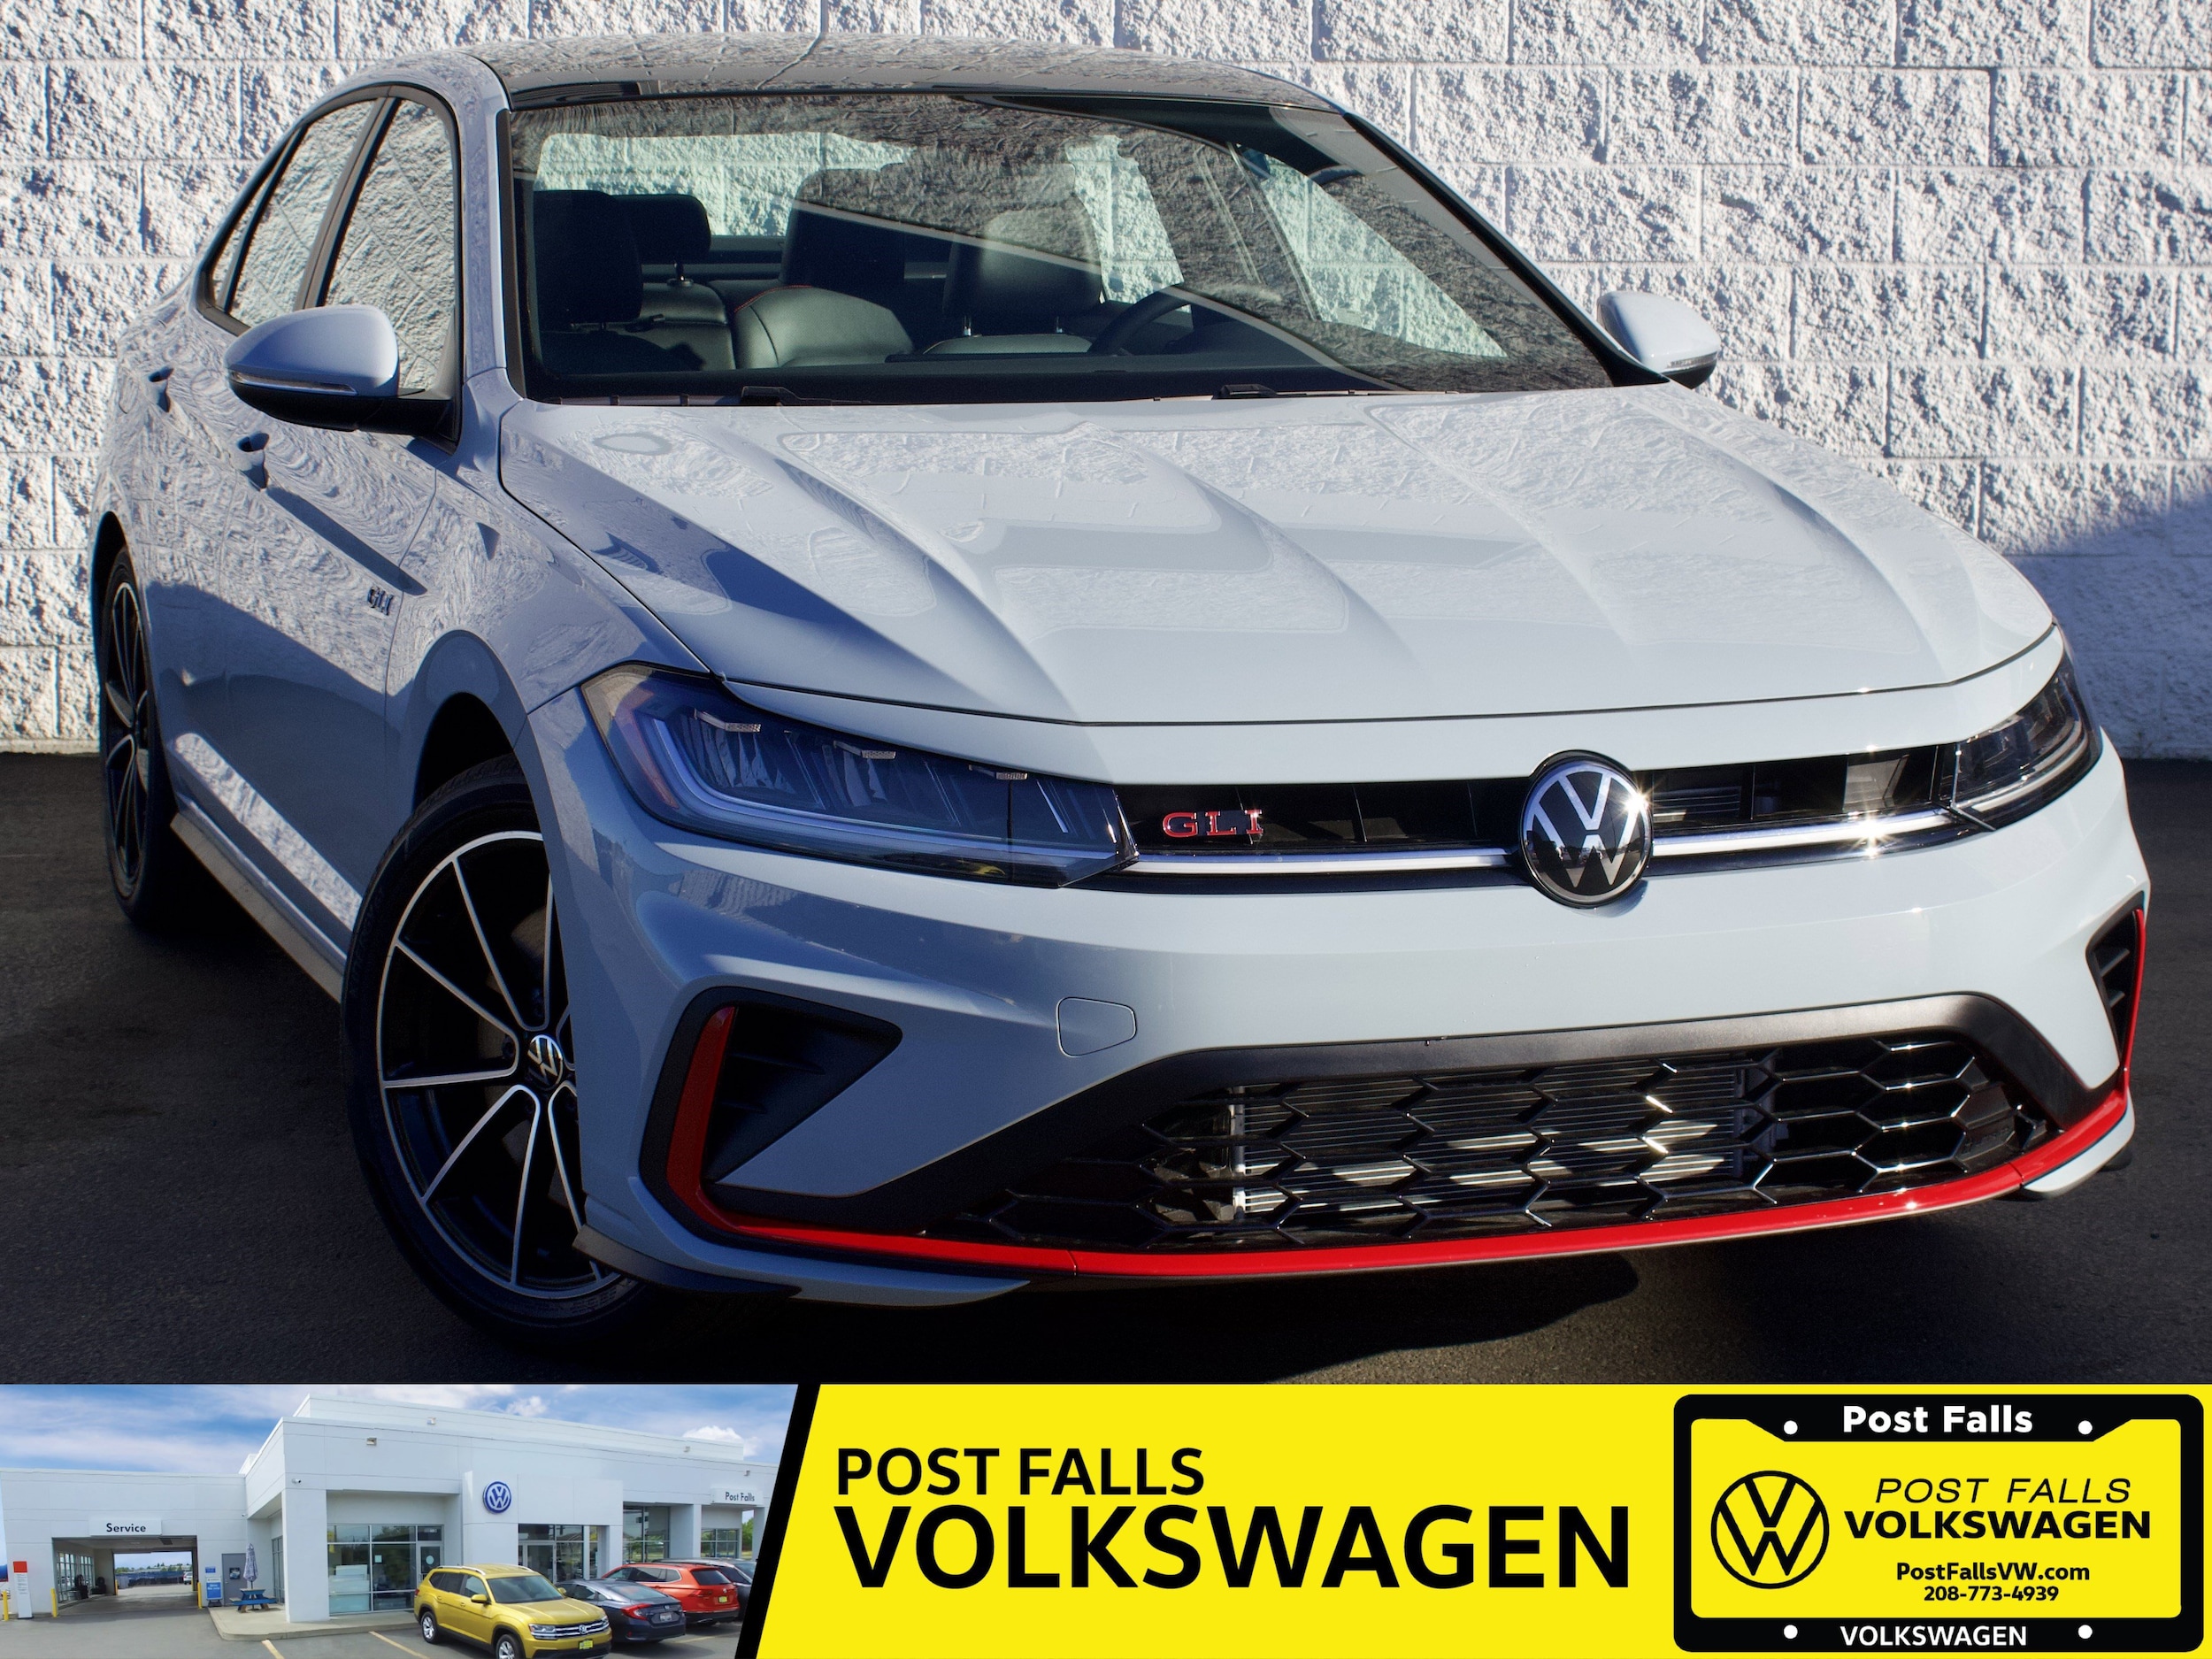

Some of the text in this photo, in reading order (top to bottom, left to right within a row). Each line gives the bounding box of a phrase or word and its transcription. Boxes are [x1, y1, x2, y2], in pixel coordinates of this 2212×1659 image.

[1163, 809, 1263, 838] GLI
[1529, 768, 1643, 889] VW
[726, 1492, 755, 1502] Post Falls
[106, 1523, 146, 1532] Service
